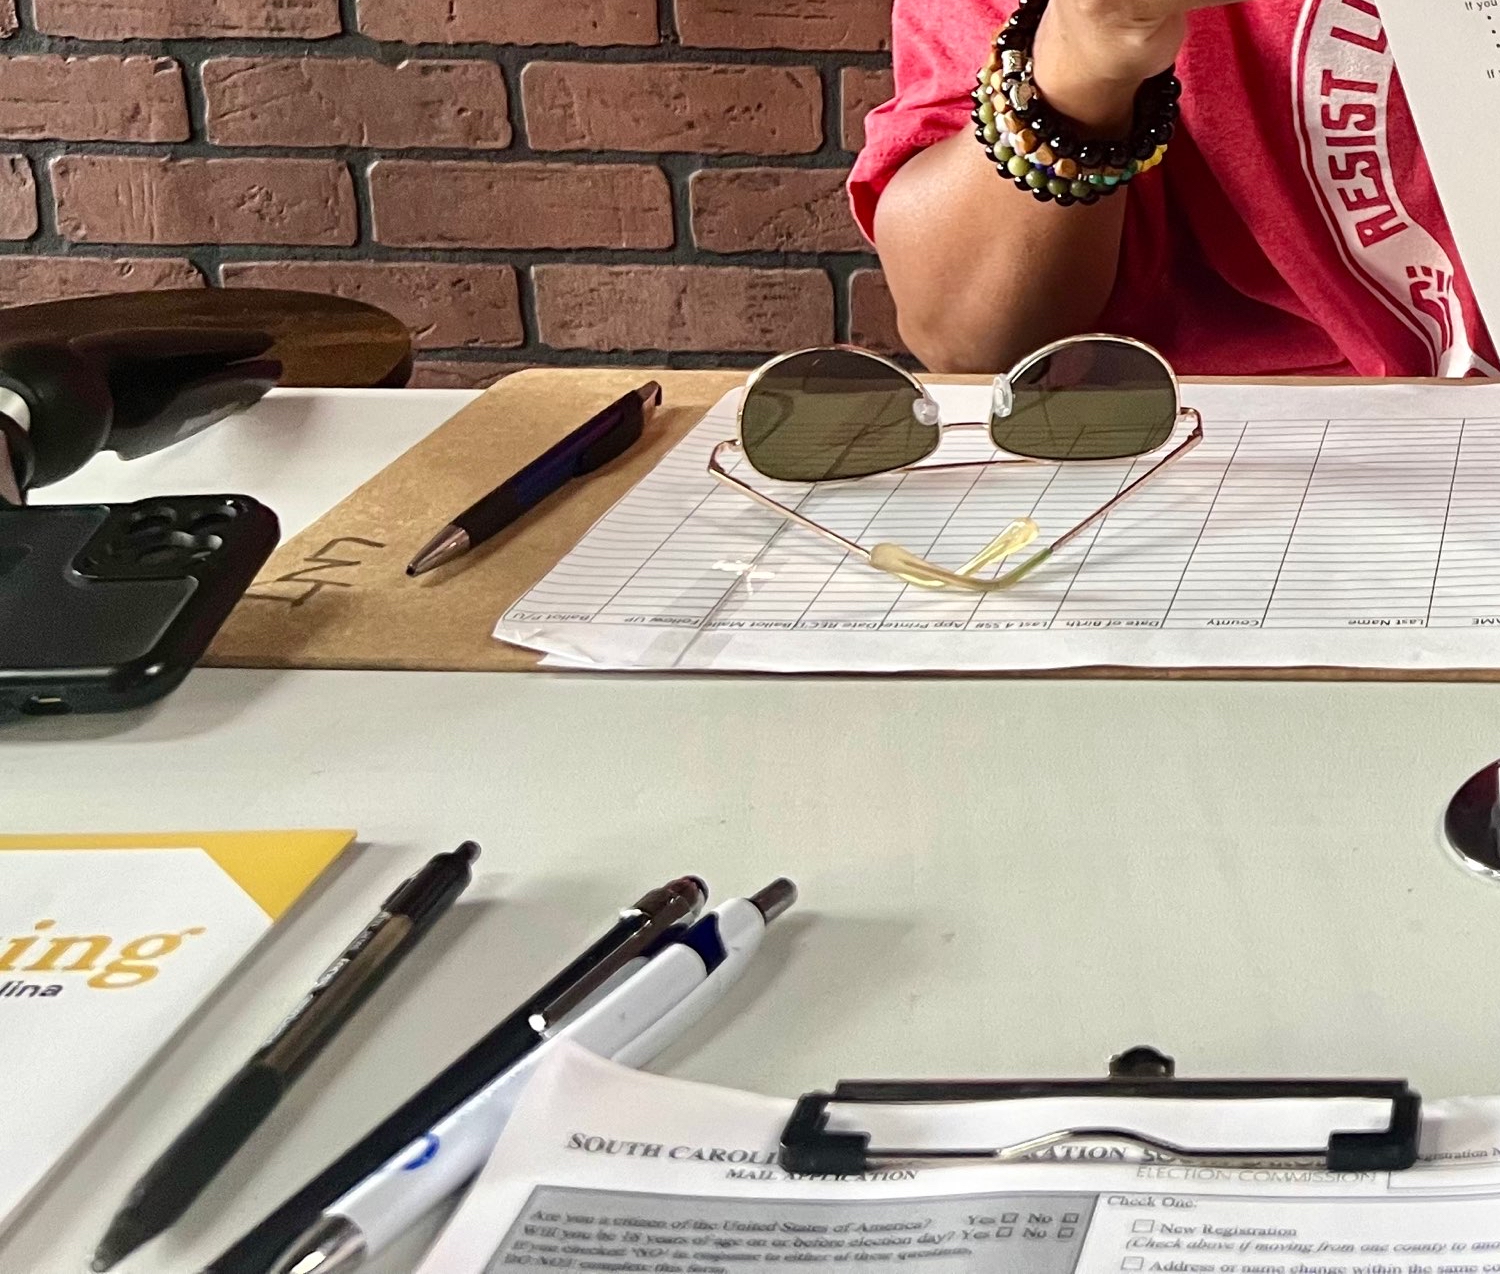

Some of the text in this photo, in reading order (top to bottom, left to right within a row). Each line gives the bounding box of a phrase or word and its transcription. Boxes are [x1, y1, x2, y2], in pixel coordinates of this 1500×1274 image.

[1464, 1, 1473, 11] If
[1476, 0, 1498, 11] you
[1320, 70, 1408, 248] RESIST
[567, 1132, 780, 1164] SOUTH CAROLI
[725, 1168, 776, 1180] MAIL
[1137, 1166, 1233, 1180] ELECTION
[1107, 1195, 1156, 1207] Check
[1159, 1223, 1297, 1237] New Registration
